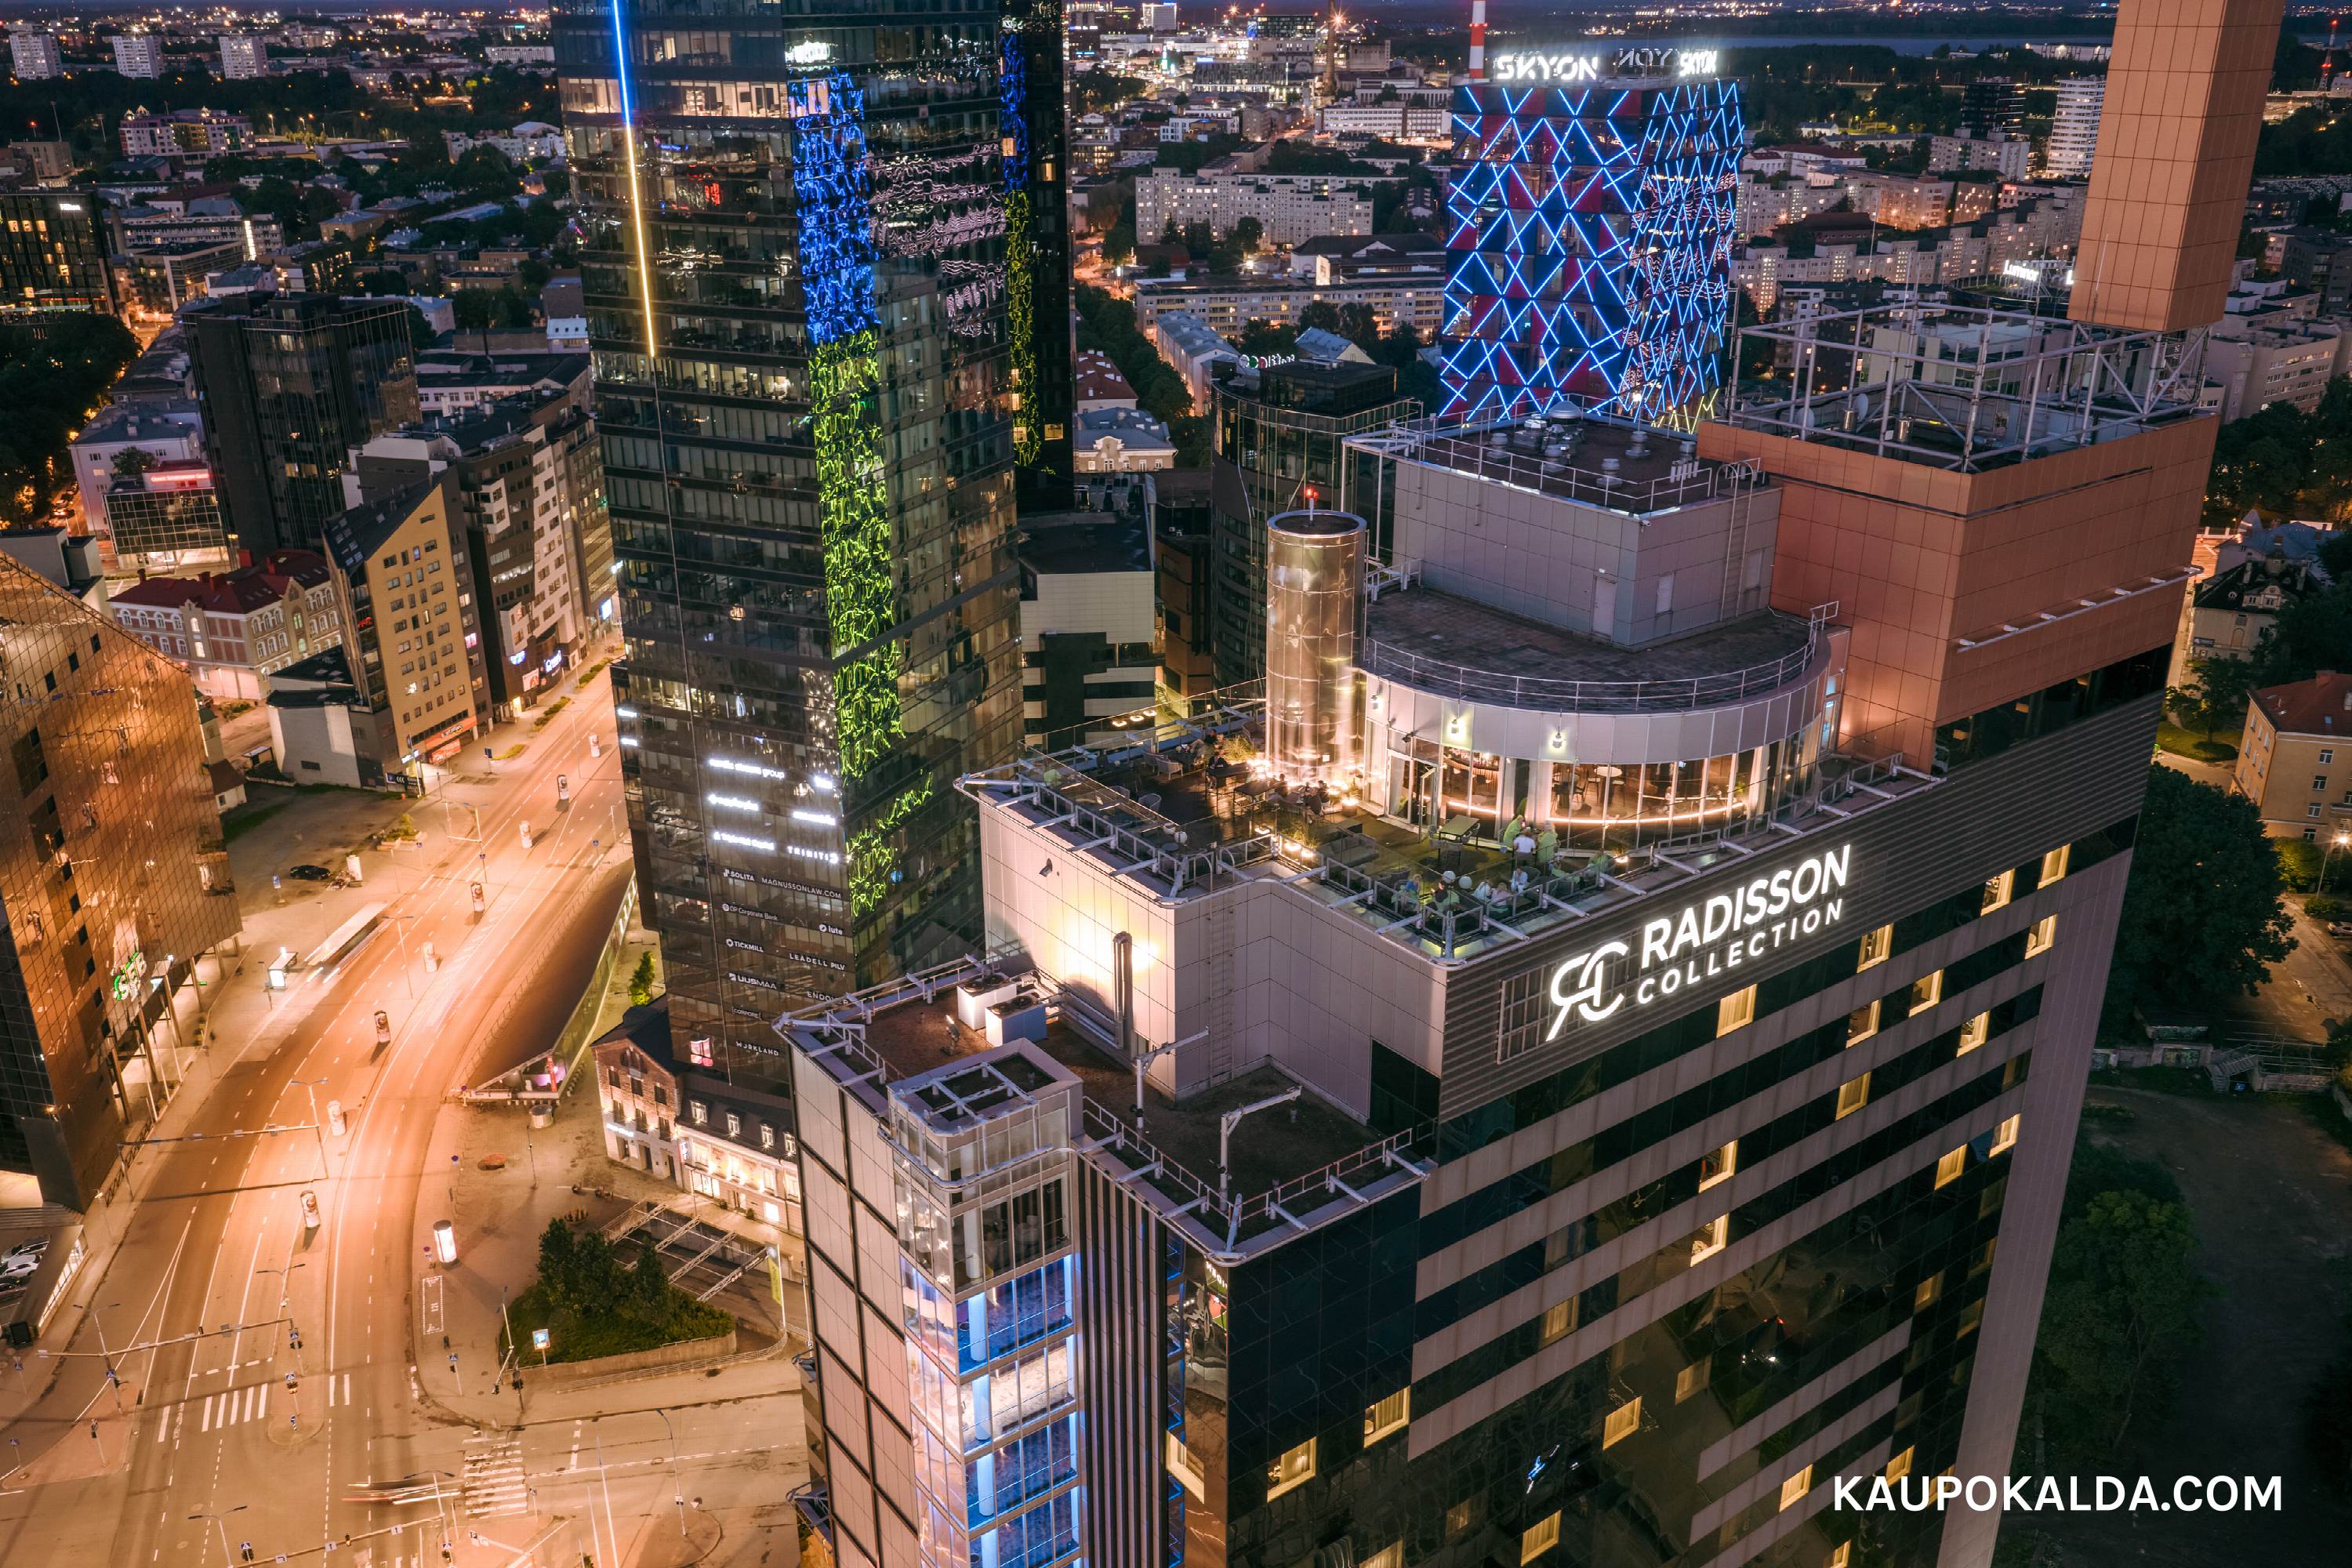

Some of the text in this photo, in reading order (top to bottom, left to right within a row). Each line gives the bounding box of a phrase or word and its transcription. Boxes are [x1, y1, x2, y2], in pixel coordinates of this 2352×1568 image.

[1496, 55, 1598, 81] SKYON
[1679, 50, 1717, 76] SKYON
[730, 870, 754, 881] SOLITA
[761, 877, 841, 899] MAGNUSSONLAW.COM
[1641, 844, 1851, 969] RADISSON
[764, 913, 779, 921] Bank
[734, 941, 764, 953] TICKMILL
[1638, 898, 1843, 1004] COLLECTION
[789, 953, 845, 971] LEADELL PILV
[738, 975, 777, 990] UUSMAA
[807, 991, 849, 1004] ENDOR
